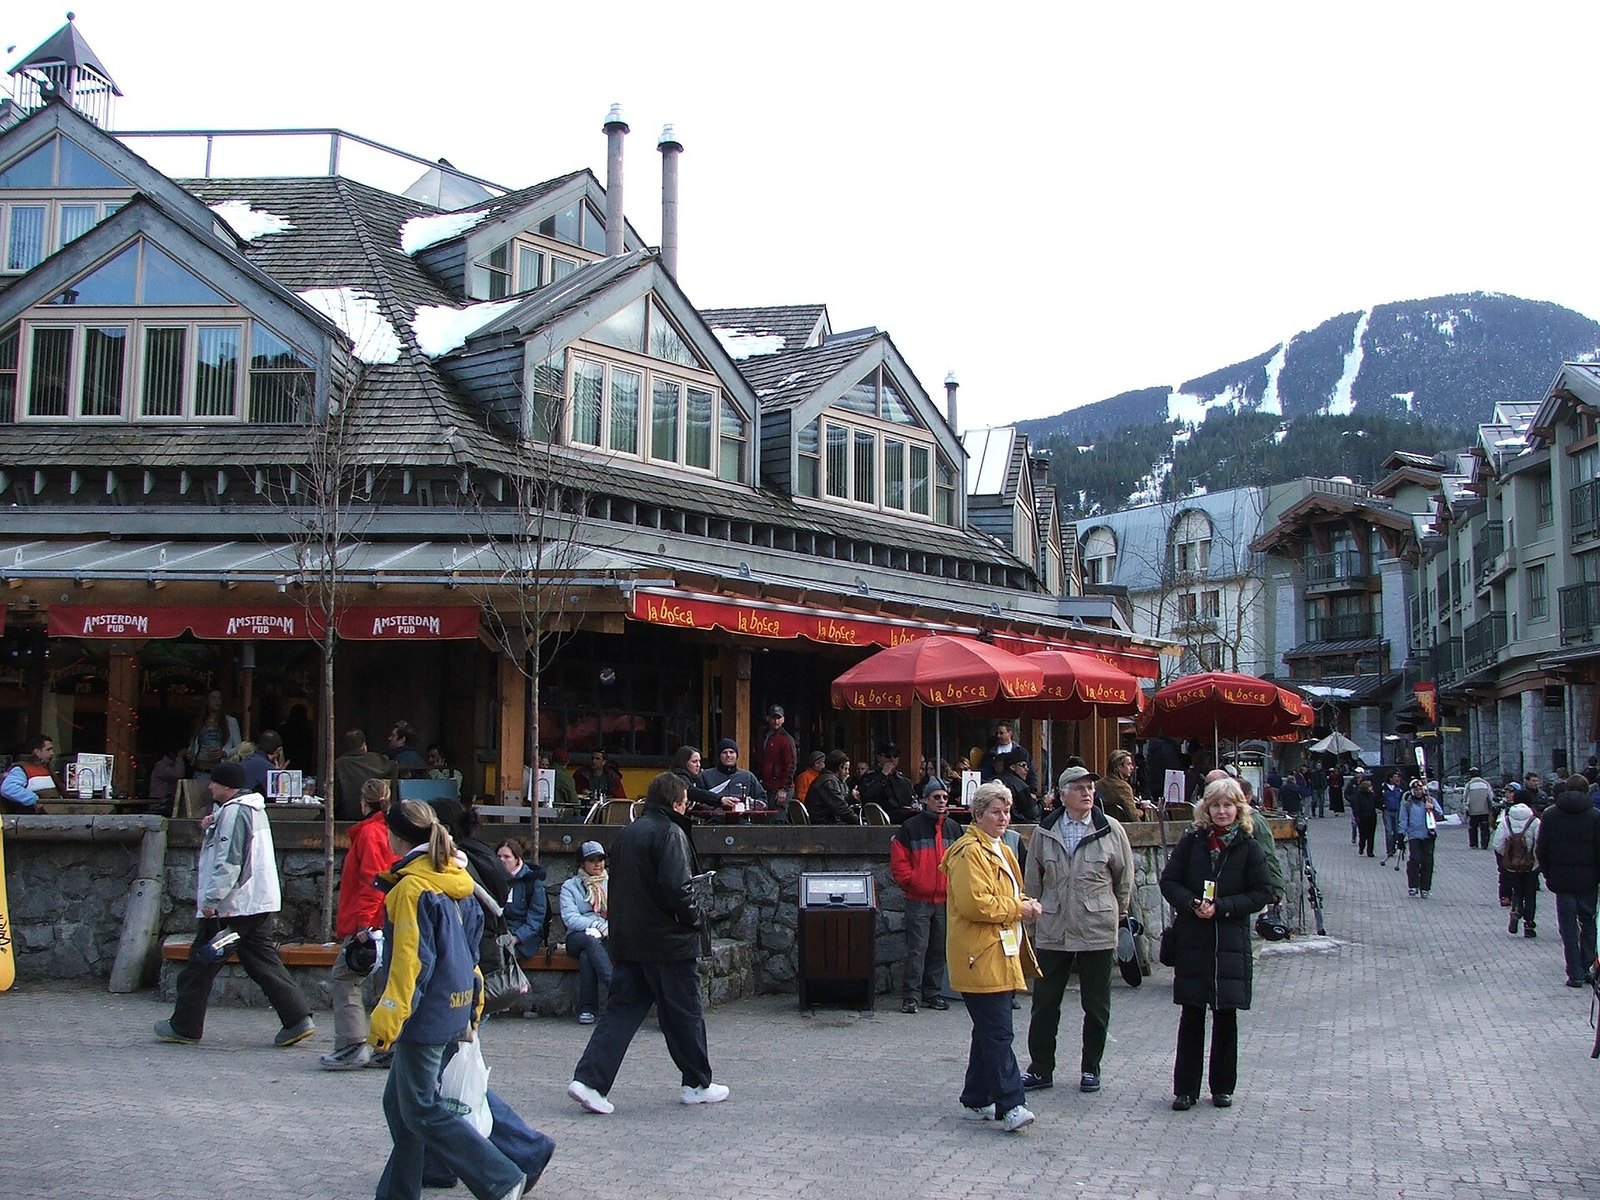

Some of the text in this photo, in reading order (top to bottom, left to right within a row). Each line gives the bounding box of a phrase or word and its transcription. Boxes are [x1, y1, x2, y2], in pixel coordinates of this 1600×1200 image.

[647, 598, 695, 627] la bocca
[83, 614, 148, 634] AMSTERDAM
[107, 624, 125, 633] PUB
[226, 615, 294, 635] AMSTERDAM
[252, 625, 270, 634] PUB
[372, 615, 441, 636] AMSTERDAM
[398, 625, 416, 634] PUB
[738, 609, 780, 637] la bocca
[816, 619, 856, 644] la bocca
[854, 690, 866, 707] la
[868, 688, 902, 707] bocca
[929, 683, 988, 703] la bocca
[1085, 683, 1127, 701] la bocca
[1176, 689, 1206, 702] bocca
[1224, 687, 1266, 704] la bocca
